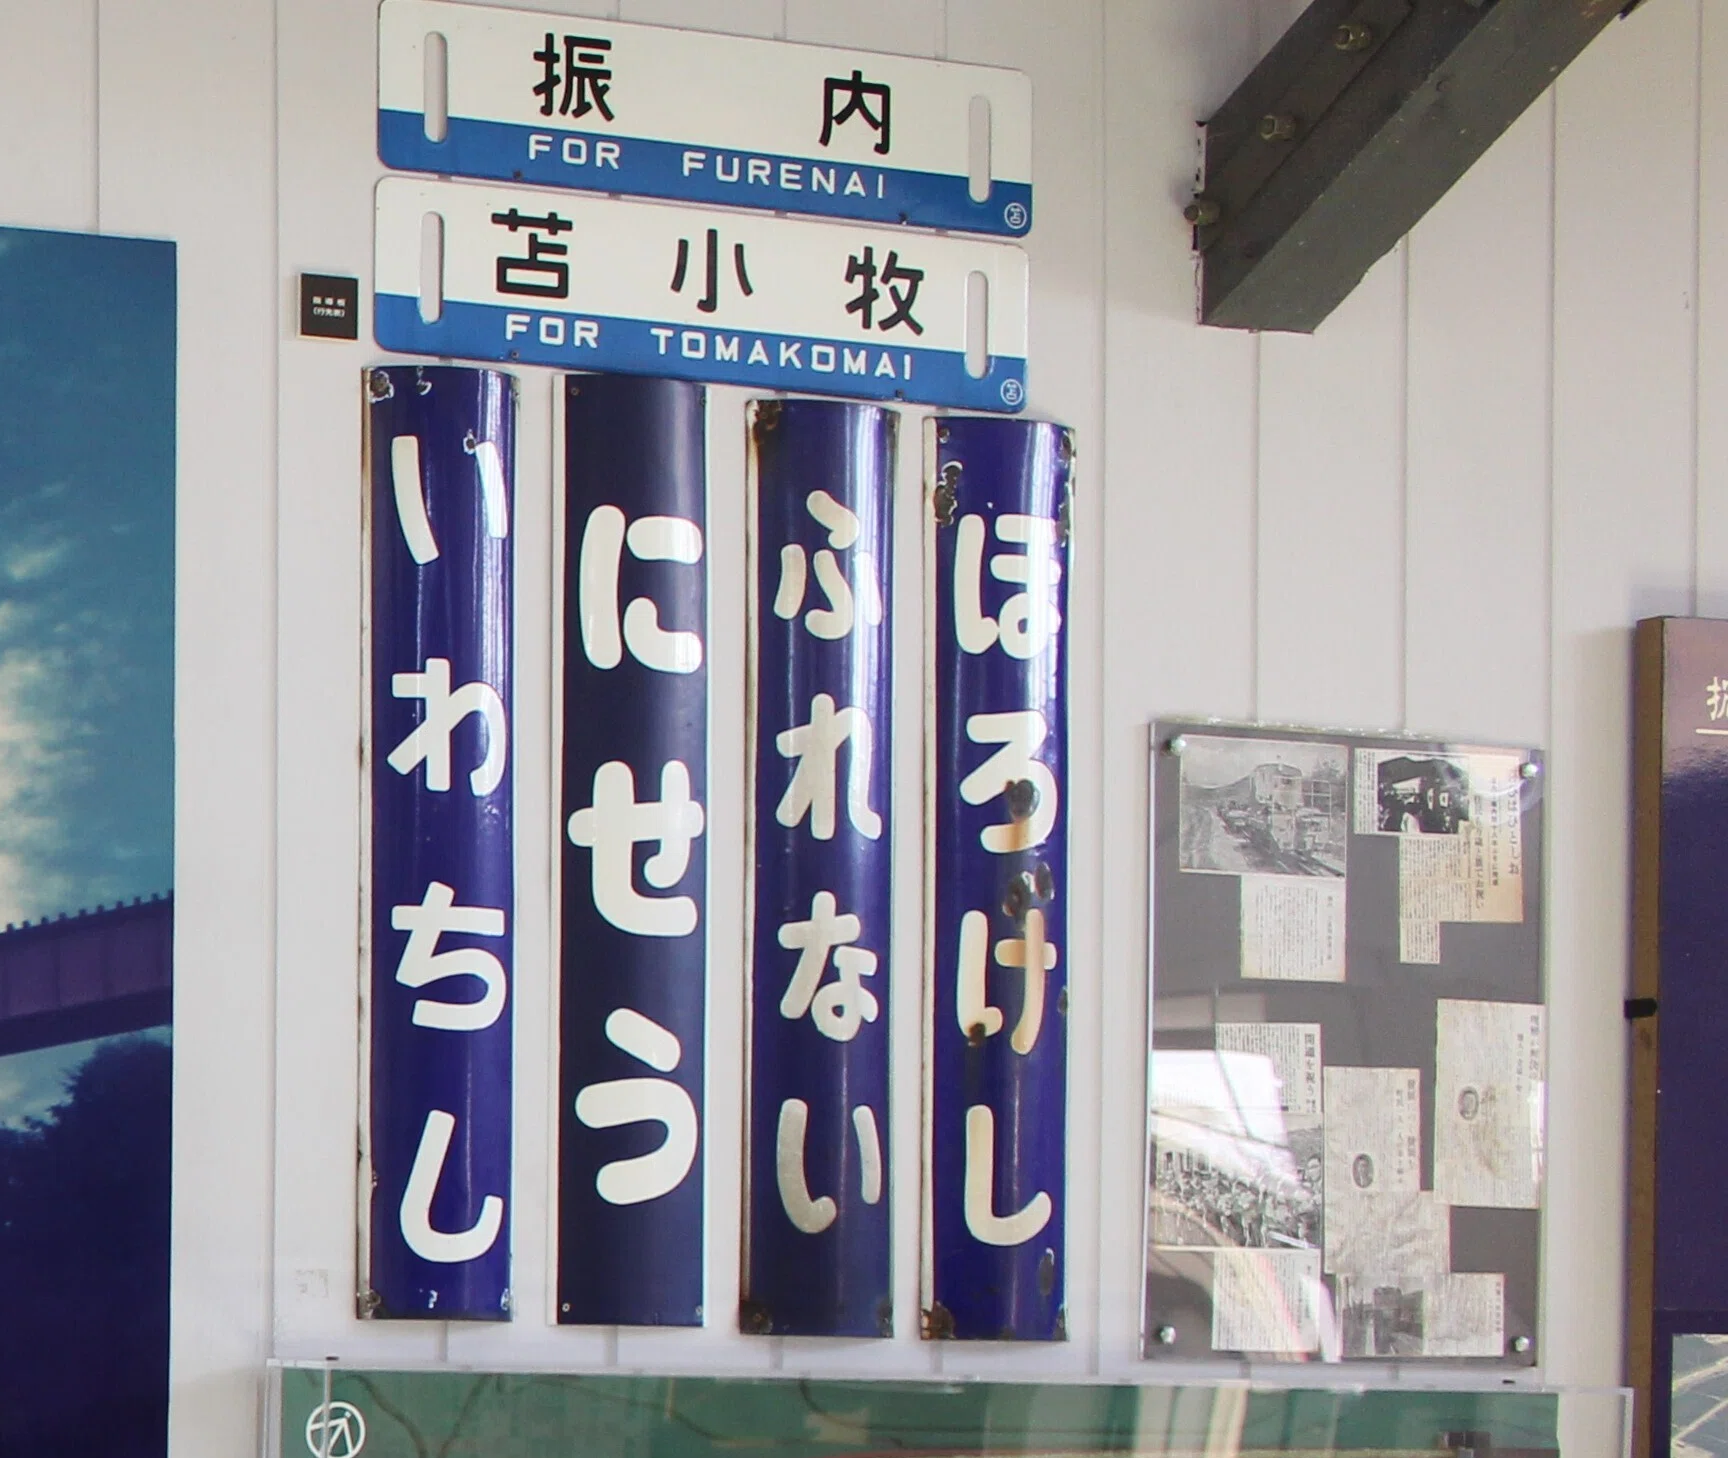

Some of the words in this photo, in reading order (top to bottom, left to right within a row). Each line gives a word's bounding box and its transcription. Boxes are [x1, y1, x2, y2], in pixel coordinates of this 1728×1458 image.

[490, 208, 925, 337] 苫小牧
[527, 133, 621, 171] FOR
[682, 152, 885, 199] FURENAI
[532, 33, 891, 155] 振内
[504, 313, 598, 350] FOR
[652, 328, 912, 381] TOMAKOMAI
[387, 434, 509, 1264] いわちし
[567, 504, 704, 1205] にせう
[774, 489, 883, 1235] ふれない
[953, 512, 1063, 1248] ほろけし
